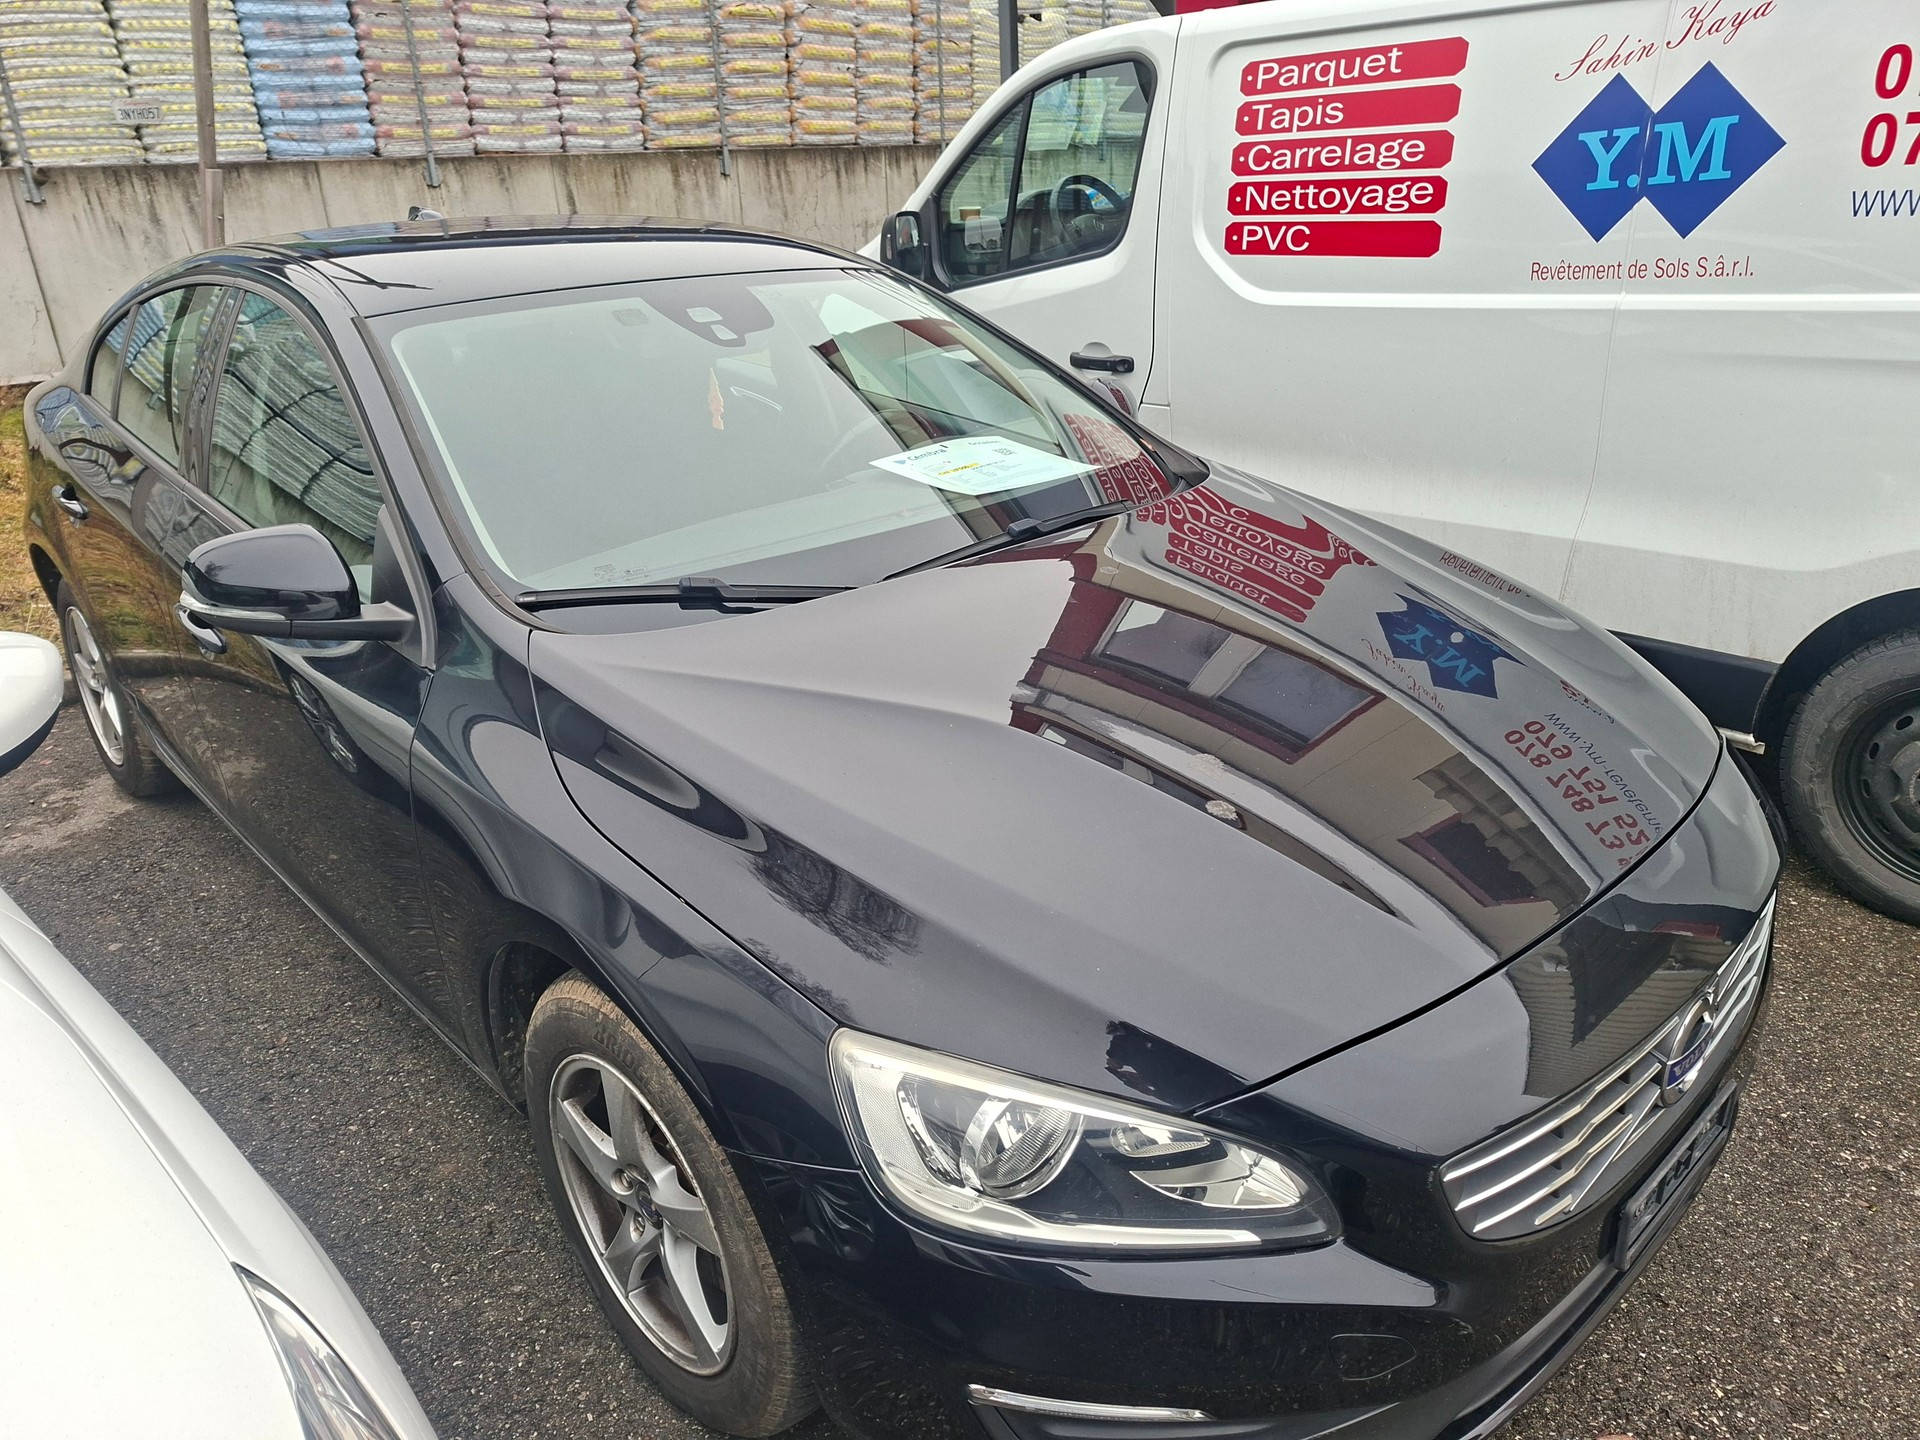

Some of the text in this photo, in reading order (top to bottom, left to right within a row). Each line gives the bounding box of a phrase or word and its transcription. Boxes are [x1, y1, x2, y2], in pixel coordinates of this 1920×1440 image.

[1554, 0, 1778, 82] Sahin Kaya
[1256, 47, 1403, 90] Parquet
[1251, 98, 1345, 133] Tapis
[1247, 138, 1426, 170] Carrelage
[1577, 114, 1740, 191] Y.M
[1245, 181, 1434, 214] Nettoyage
[1241, 225, 1311, 252] PVC
[1530, 254, 1755, 281] Revêtement de Sols S.â.r.l.
